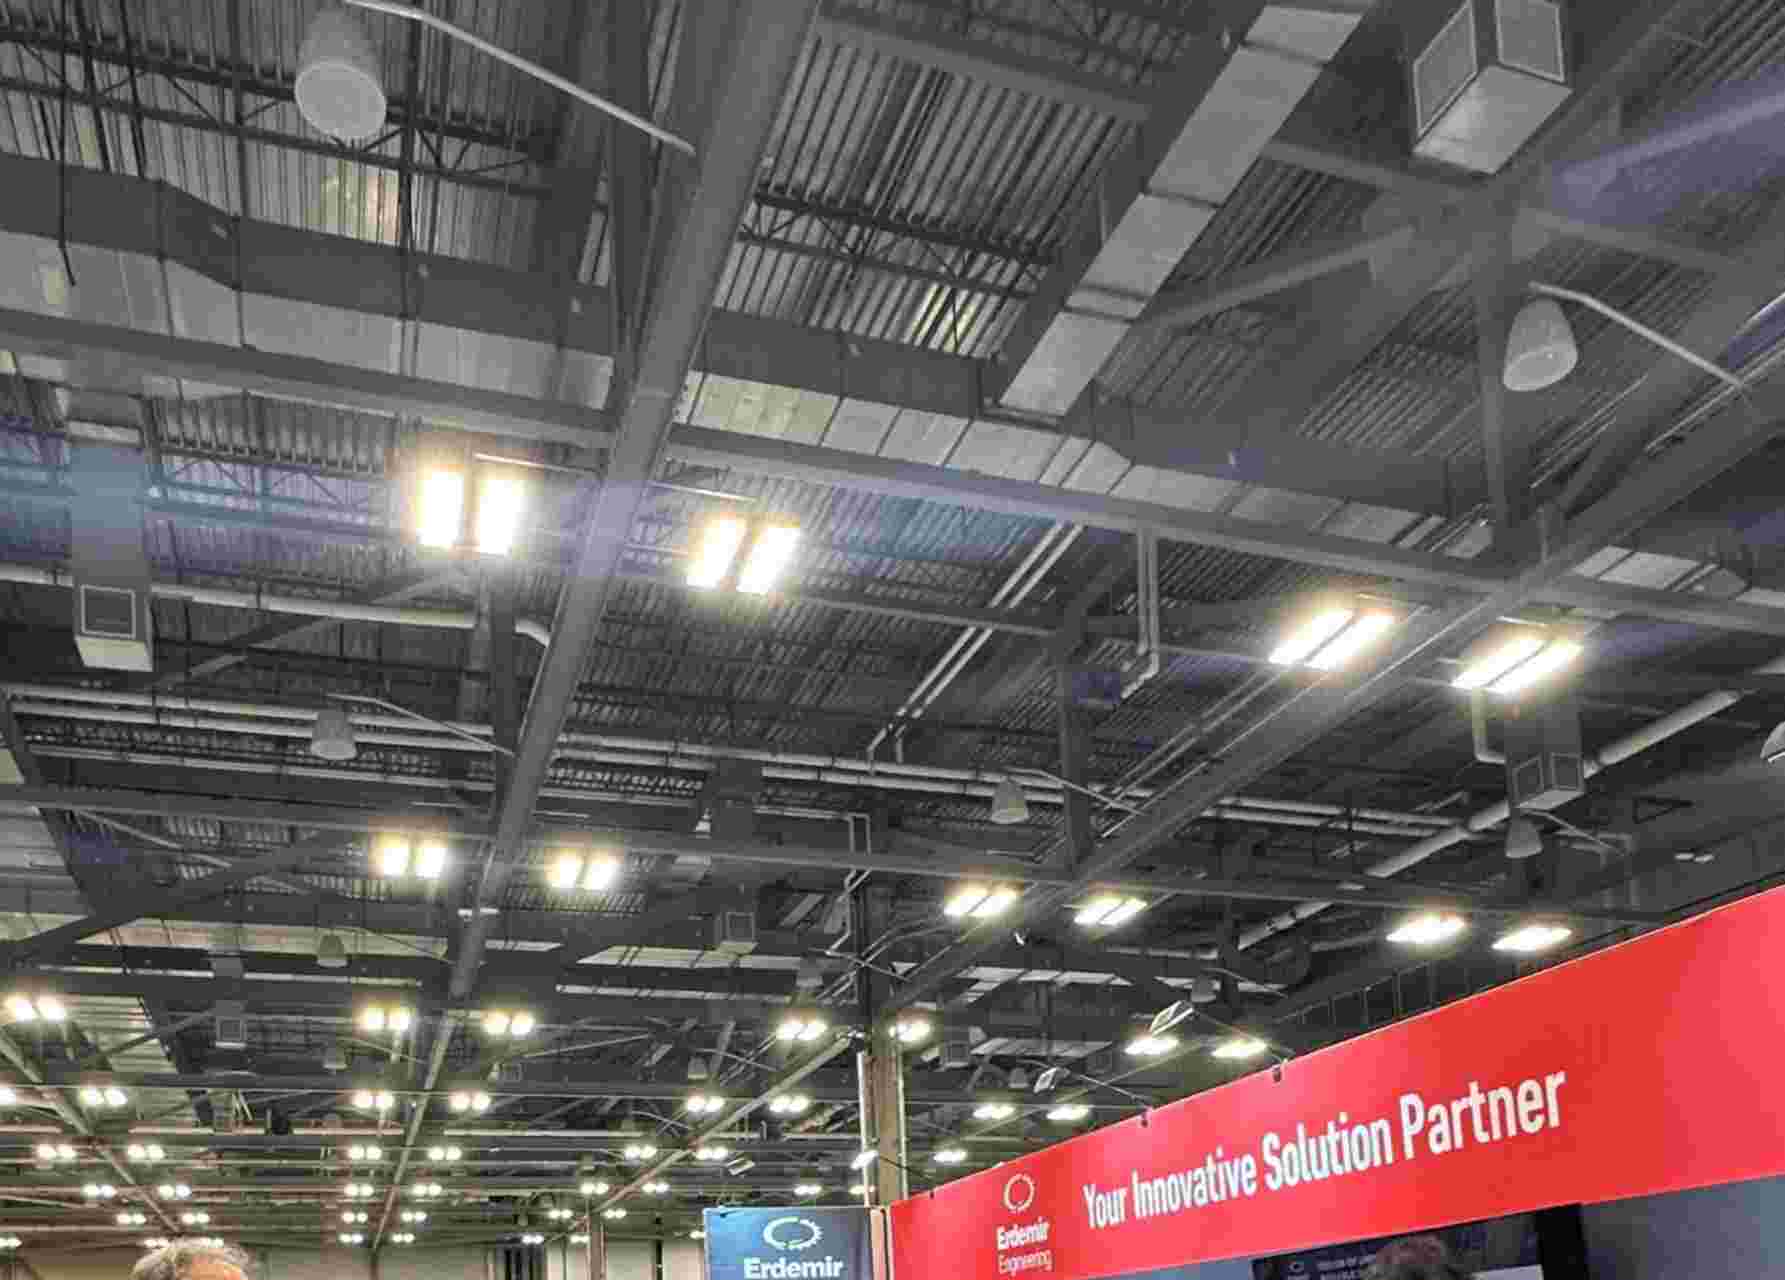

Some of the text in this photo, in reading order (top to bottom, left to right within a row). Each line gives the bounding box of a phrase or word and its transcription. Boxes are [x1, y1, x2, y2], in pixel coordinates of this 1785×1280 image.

[1083, 1070, 1567, 1229] Your Innovative Solution Partner
[997, 1217, 1049, 1249] Erdemir
[744, 1256, 844, 1280] Erdemir
[998, 1250, 1053, 1276] Engineering
